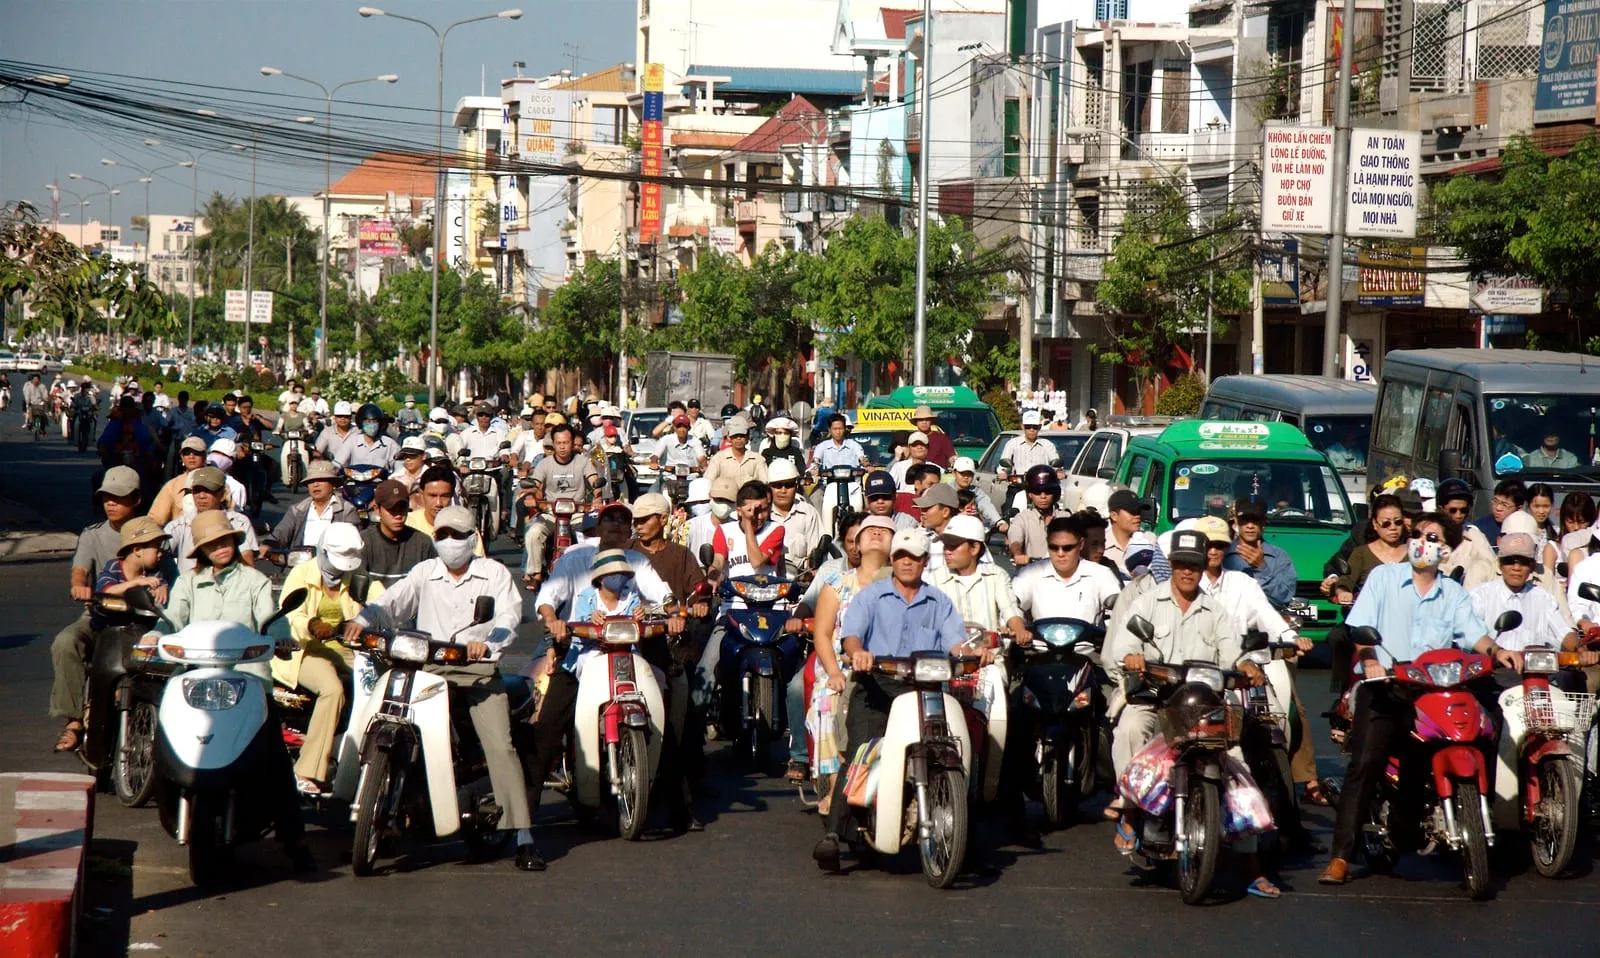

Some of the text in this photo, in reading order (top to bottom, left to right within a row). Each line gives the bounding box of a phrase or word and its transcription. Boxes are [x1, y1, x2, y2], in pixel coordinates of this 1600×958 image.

[1268, 131, 1292, 143] KHÔNG
[1308, 131, 1331, 144] CHIẾM
[1367, 134, 1405, 150] AN TOÀN
[527, 138, 555, 152] QUANG
[1360, 154, 1410, 169] GIAO THÔNG
[1353, 169, 1414, 188] LÀ HẠNH PHÚC
[1277, 193, 1313, 206] BUÔN BÁN
[1351, 187, 1368, 204] CỦA
[1369, 193, 1385, 208] MỌI
[1295, 211, 1305, 221] XE
[1363, 209, 1397, 227] MỌI NHÀ
[862, 411, 913, 421] VINATAXI
